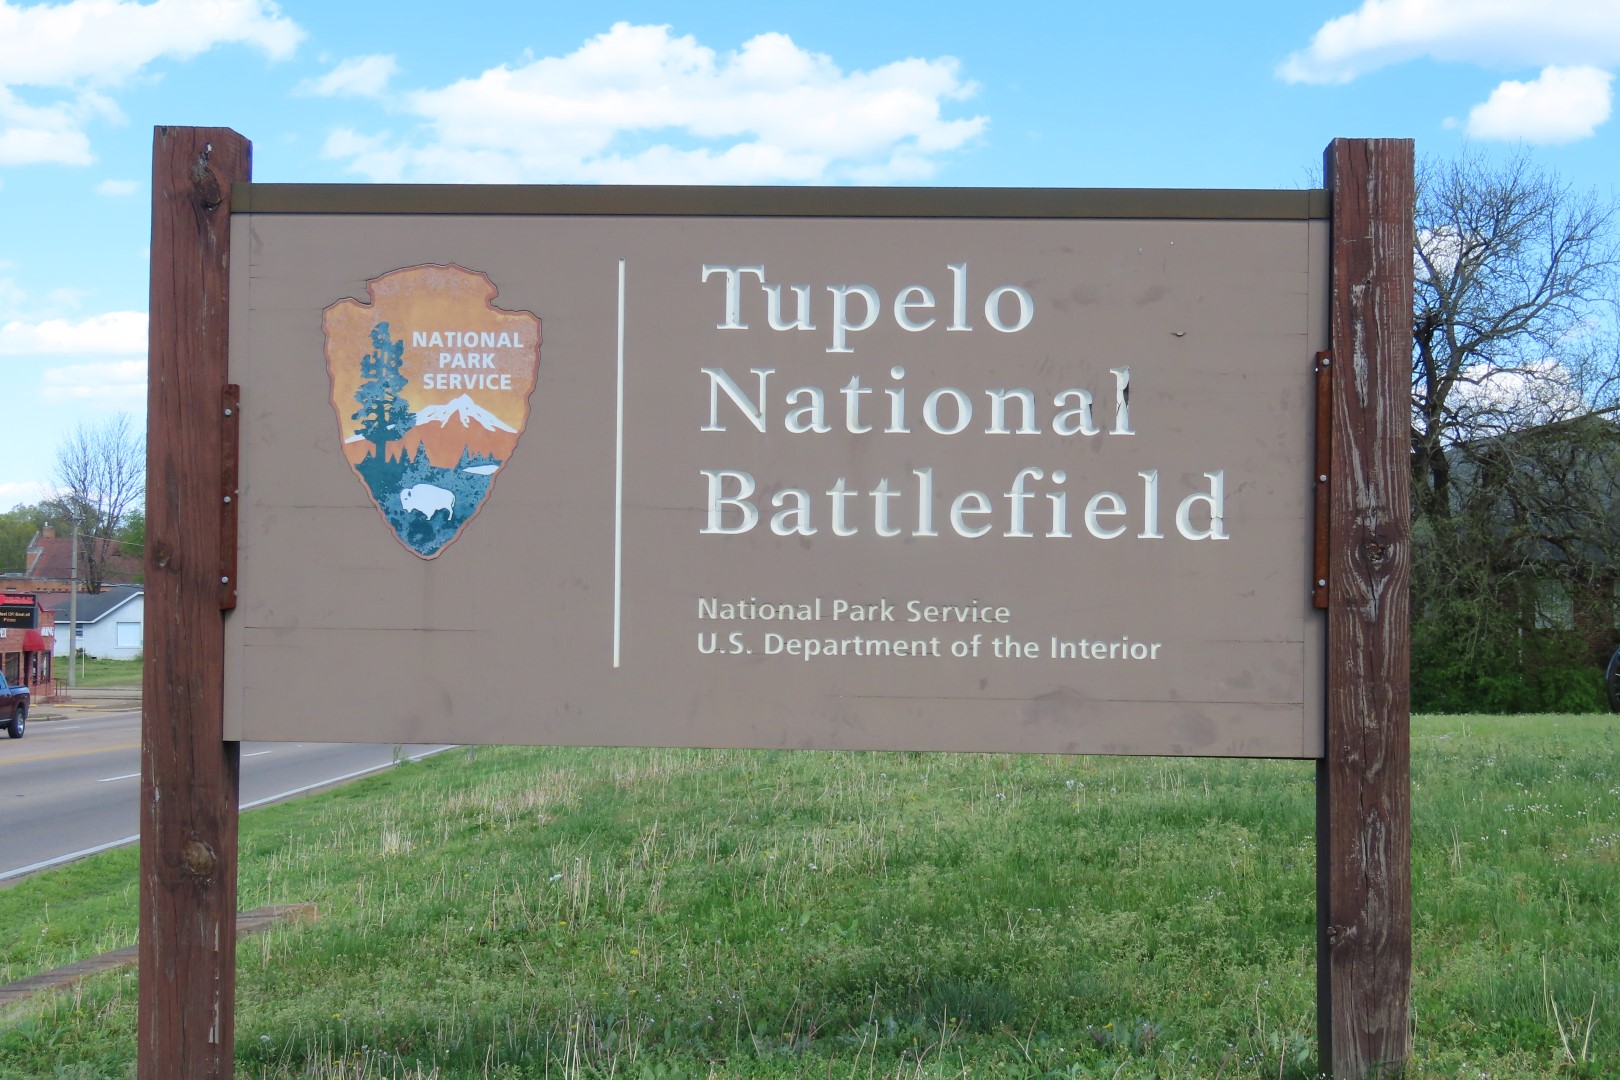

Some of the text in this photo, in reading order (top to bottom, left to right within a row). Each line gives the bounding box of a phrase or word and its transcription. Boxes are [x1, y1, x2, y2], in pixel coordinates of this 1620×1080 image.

[701, 261, 1035, 354] Tupelo
[413, 331, 524, 349] NATIONAL
[439, 351, 496, 369] PARK
[423, 373, 512, 391] SERVICE
[700, 365, 1136, 437] National
[699, 467, 1230, 541] Battlefield
[698, 597, 1011, 624] National Park Service
[697, 632, 1162, 662] U.S. Department of the Interior
